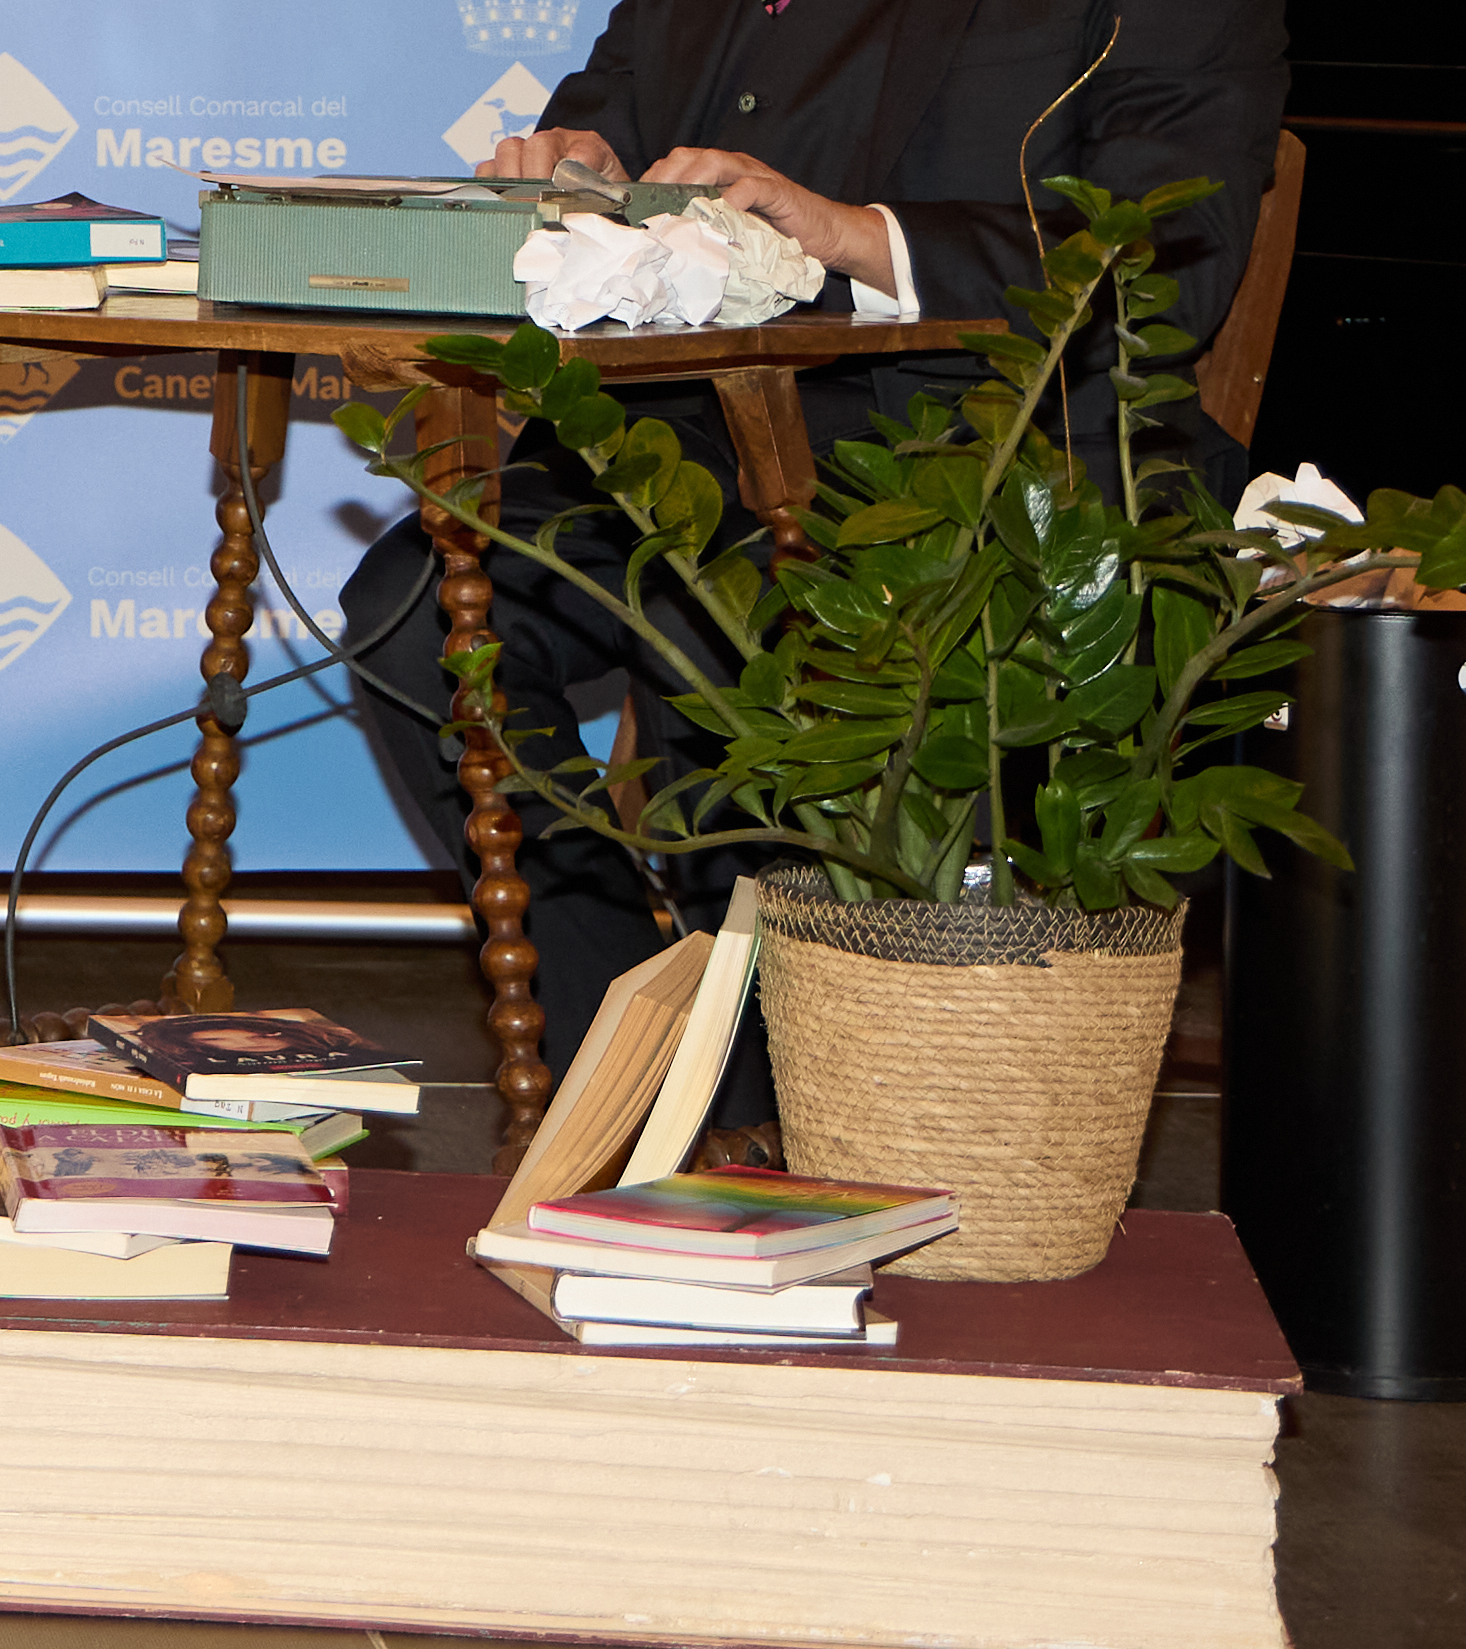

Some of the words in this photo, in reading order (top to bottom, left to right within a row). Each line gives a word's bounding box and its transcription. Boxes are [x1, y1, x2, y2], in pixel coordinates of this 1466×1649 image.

[94, 95, 183, 116] Consell
[189, 95, 305, 117] Comarcal
[311, 96, 347, 117] del
[96, 127, 347, 169] Maresme
